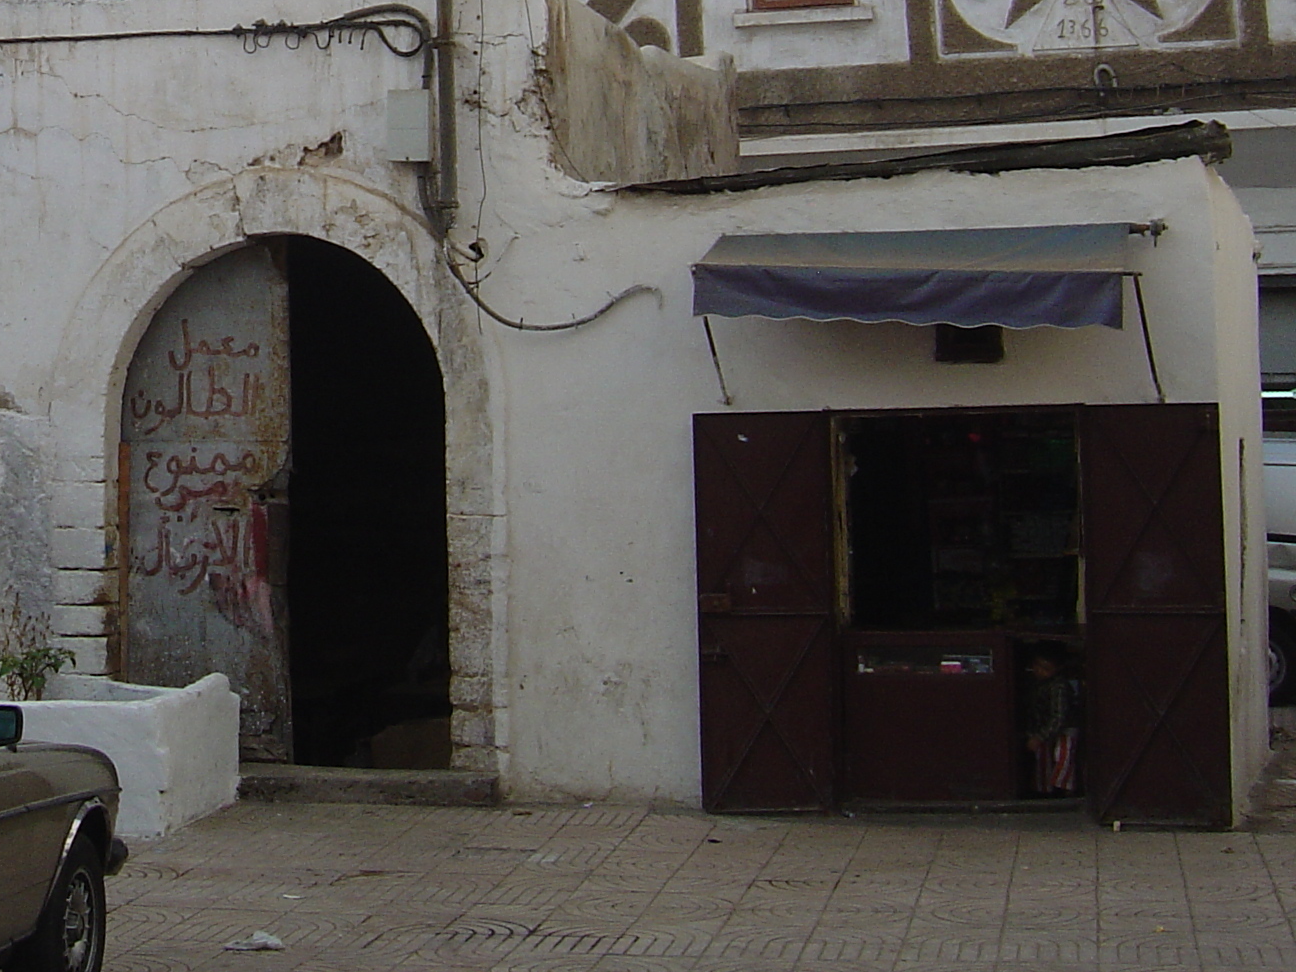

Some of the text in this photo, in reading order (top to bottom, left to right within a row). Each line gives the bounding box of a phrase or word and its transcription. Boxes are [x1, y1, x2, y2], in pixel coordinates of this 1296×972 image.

[1057, 18, 1109, 38] 1366
[168, 318, 260, 369] معمل
[144, 446, 257, 497] ممنوع
